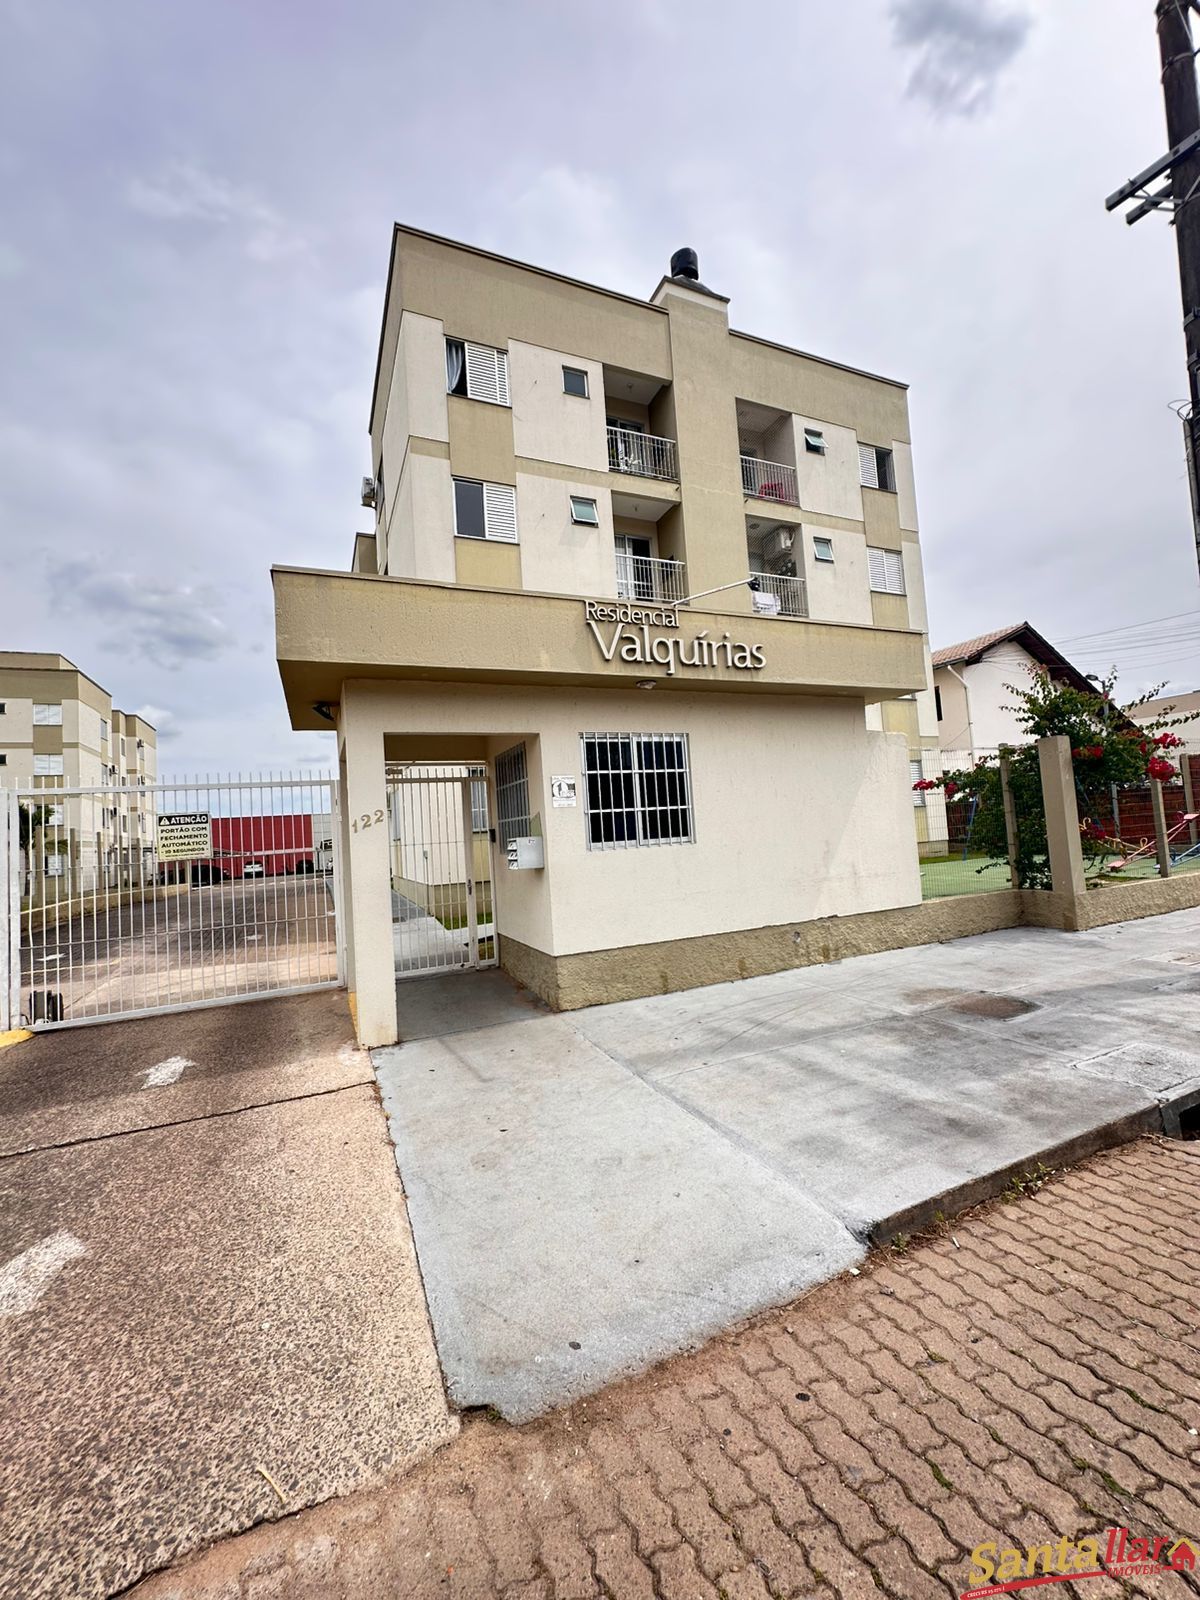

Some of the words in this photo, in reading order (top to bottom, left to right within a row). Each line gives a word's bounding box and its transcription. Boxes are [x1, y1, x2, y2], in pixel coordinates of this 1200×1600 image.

[584, 600, 680, 628] Residencial
[586, 620, 767, 675] Valquírias
[170, 815, 207, 824] ATENÇÃO
[352, 809, 384, 834] 122
